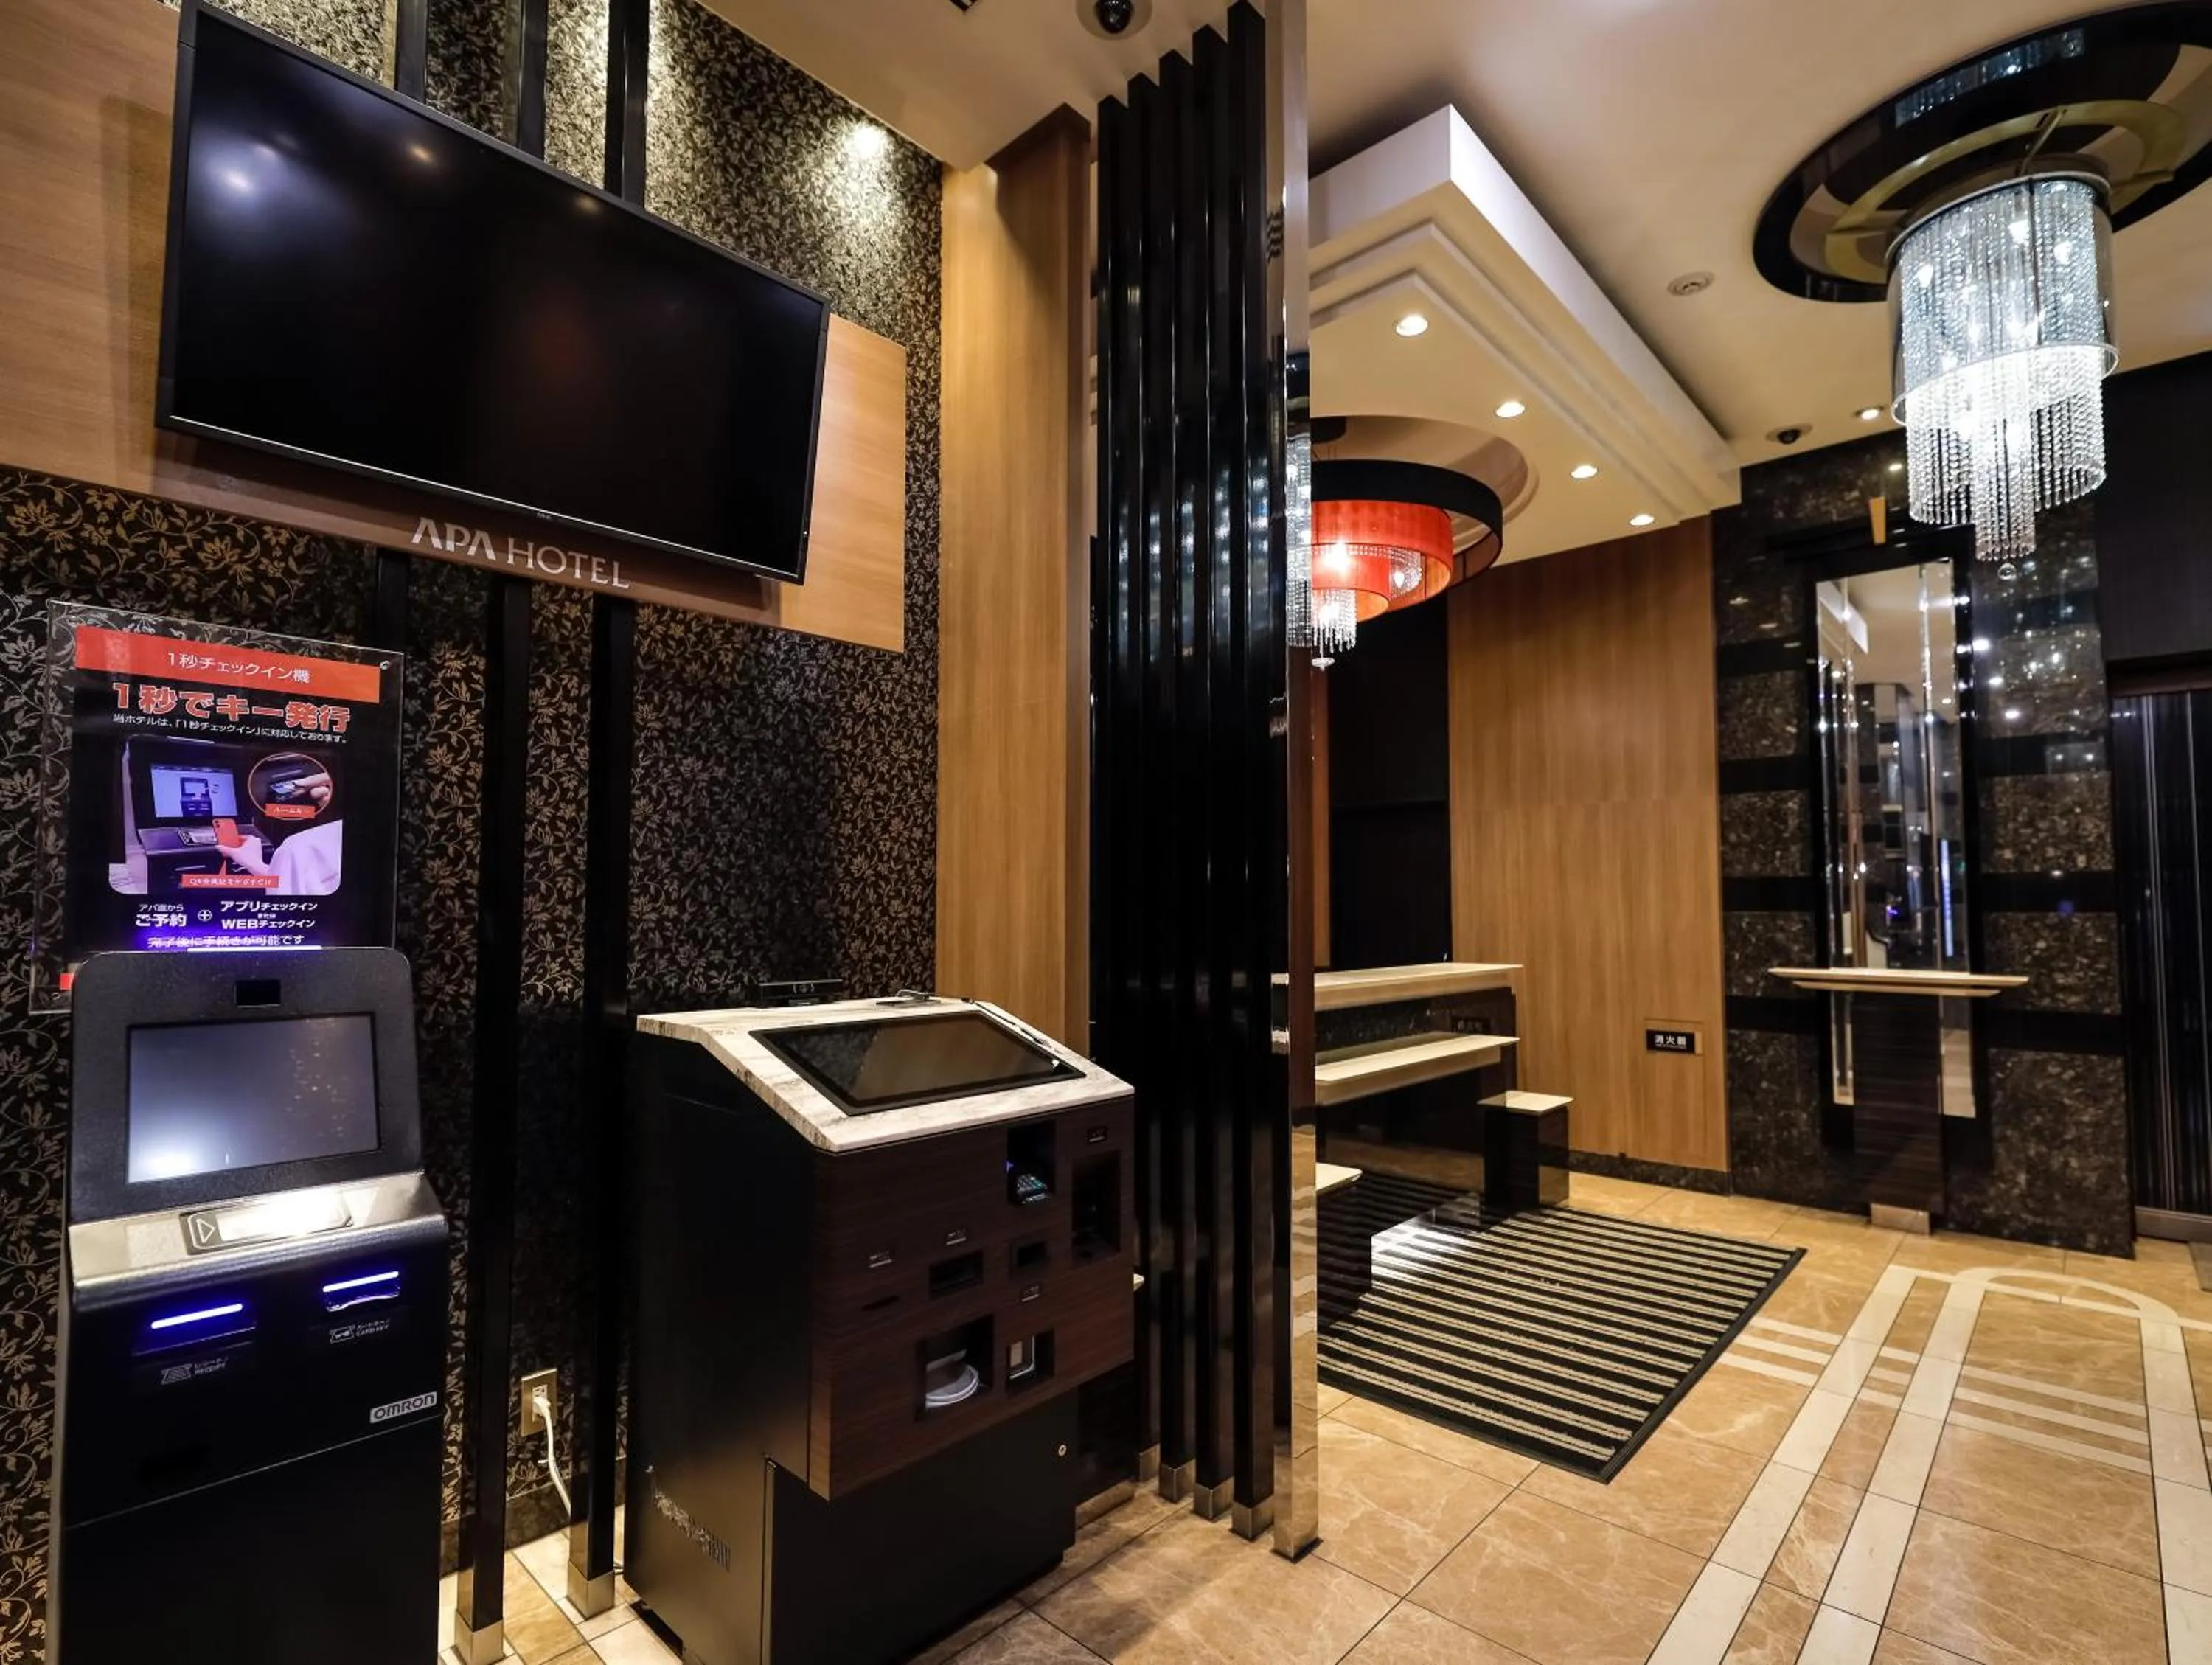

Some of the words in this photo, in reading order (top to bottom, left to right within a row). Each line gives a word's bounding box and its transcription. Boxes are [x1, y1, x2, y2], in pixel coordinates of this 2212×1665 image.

[411, 517, 497, 561] APA
[506, 536, 630, 589] HOTEL
[167, 652, 311, 684] 1秒チェックイン機
[112, 682, 351, 733] 1秒でキー発行
[135, 914, 188, 928] ご予約
